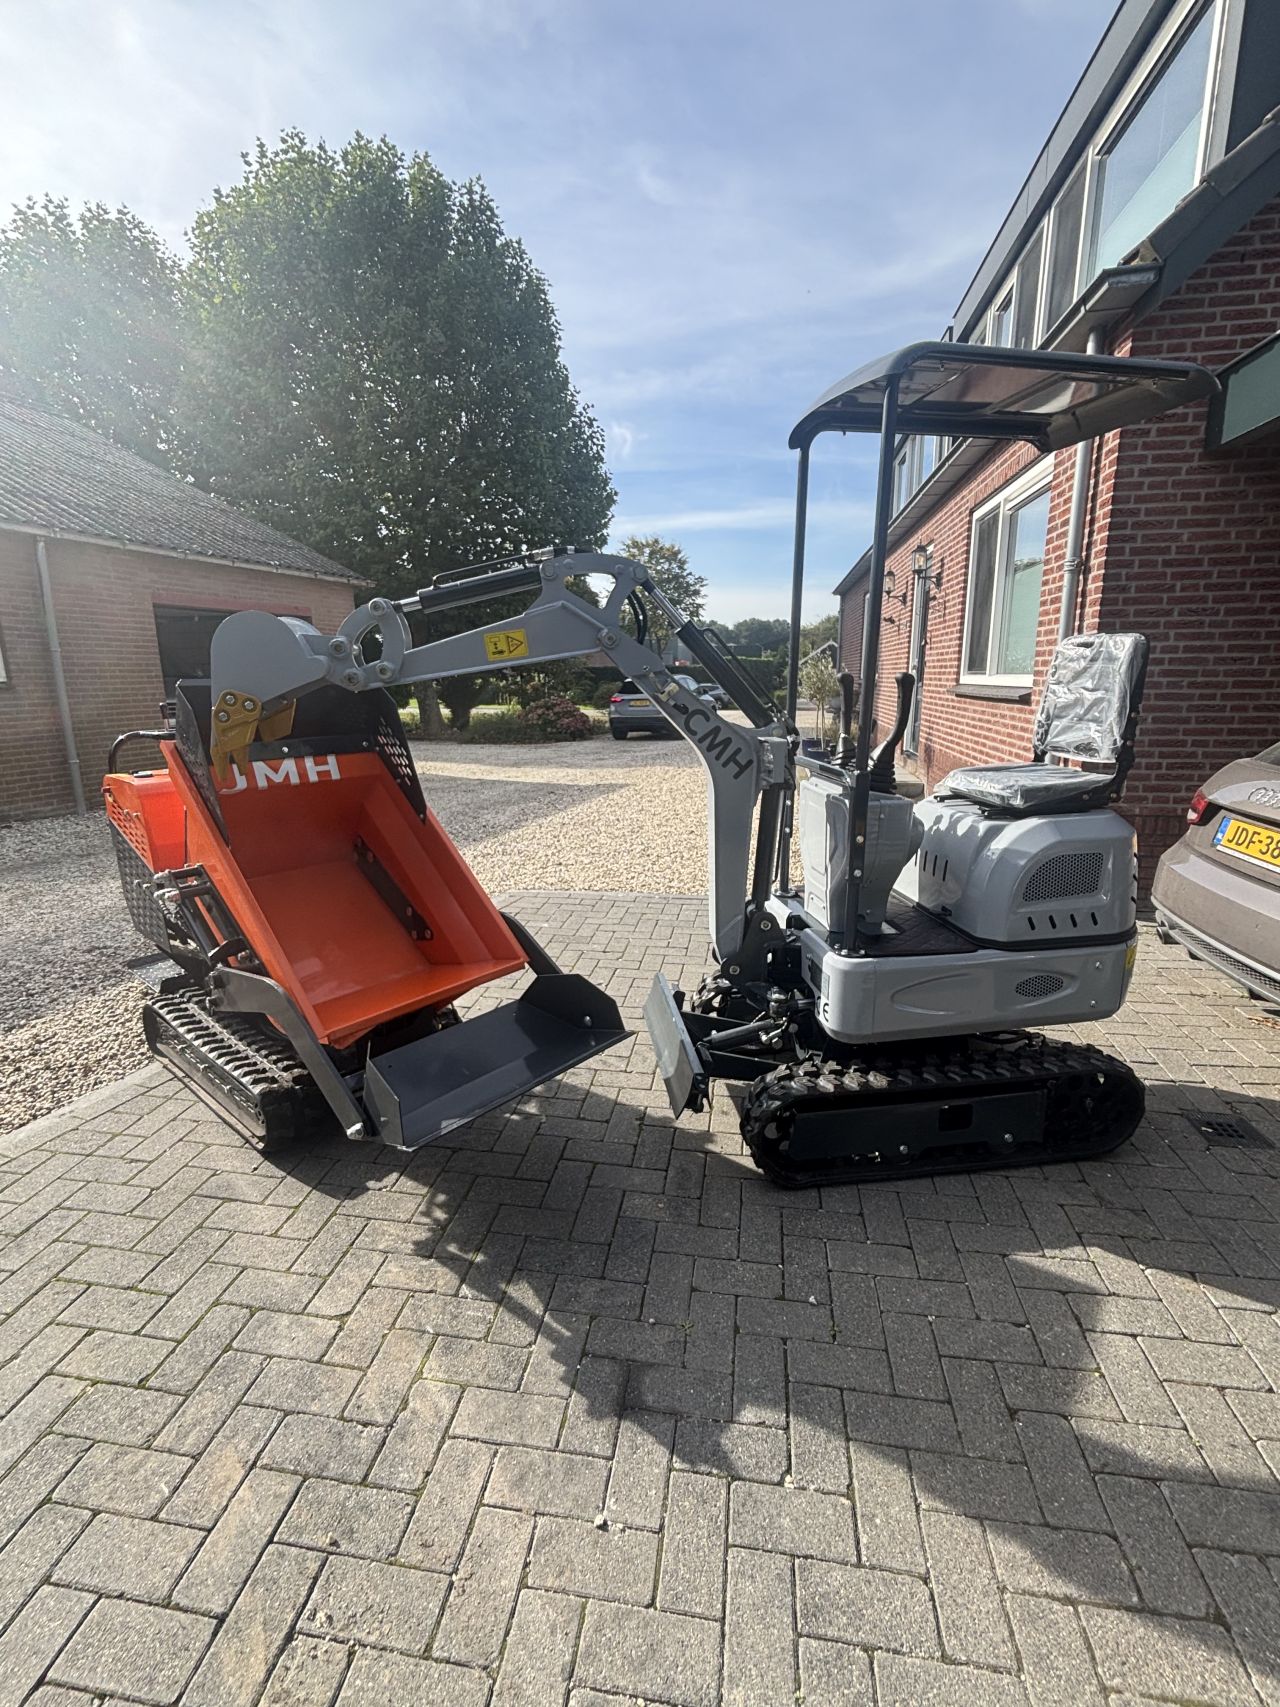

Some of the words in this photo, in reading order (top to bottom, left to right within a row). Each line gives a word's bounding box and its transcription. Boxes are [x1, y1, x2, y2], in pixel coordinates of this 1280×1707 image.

[684, 708, 754, 780] CMH
[218, 753, 342, 795] JMH
[1226, 825, 1280, 860] JDF-38
